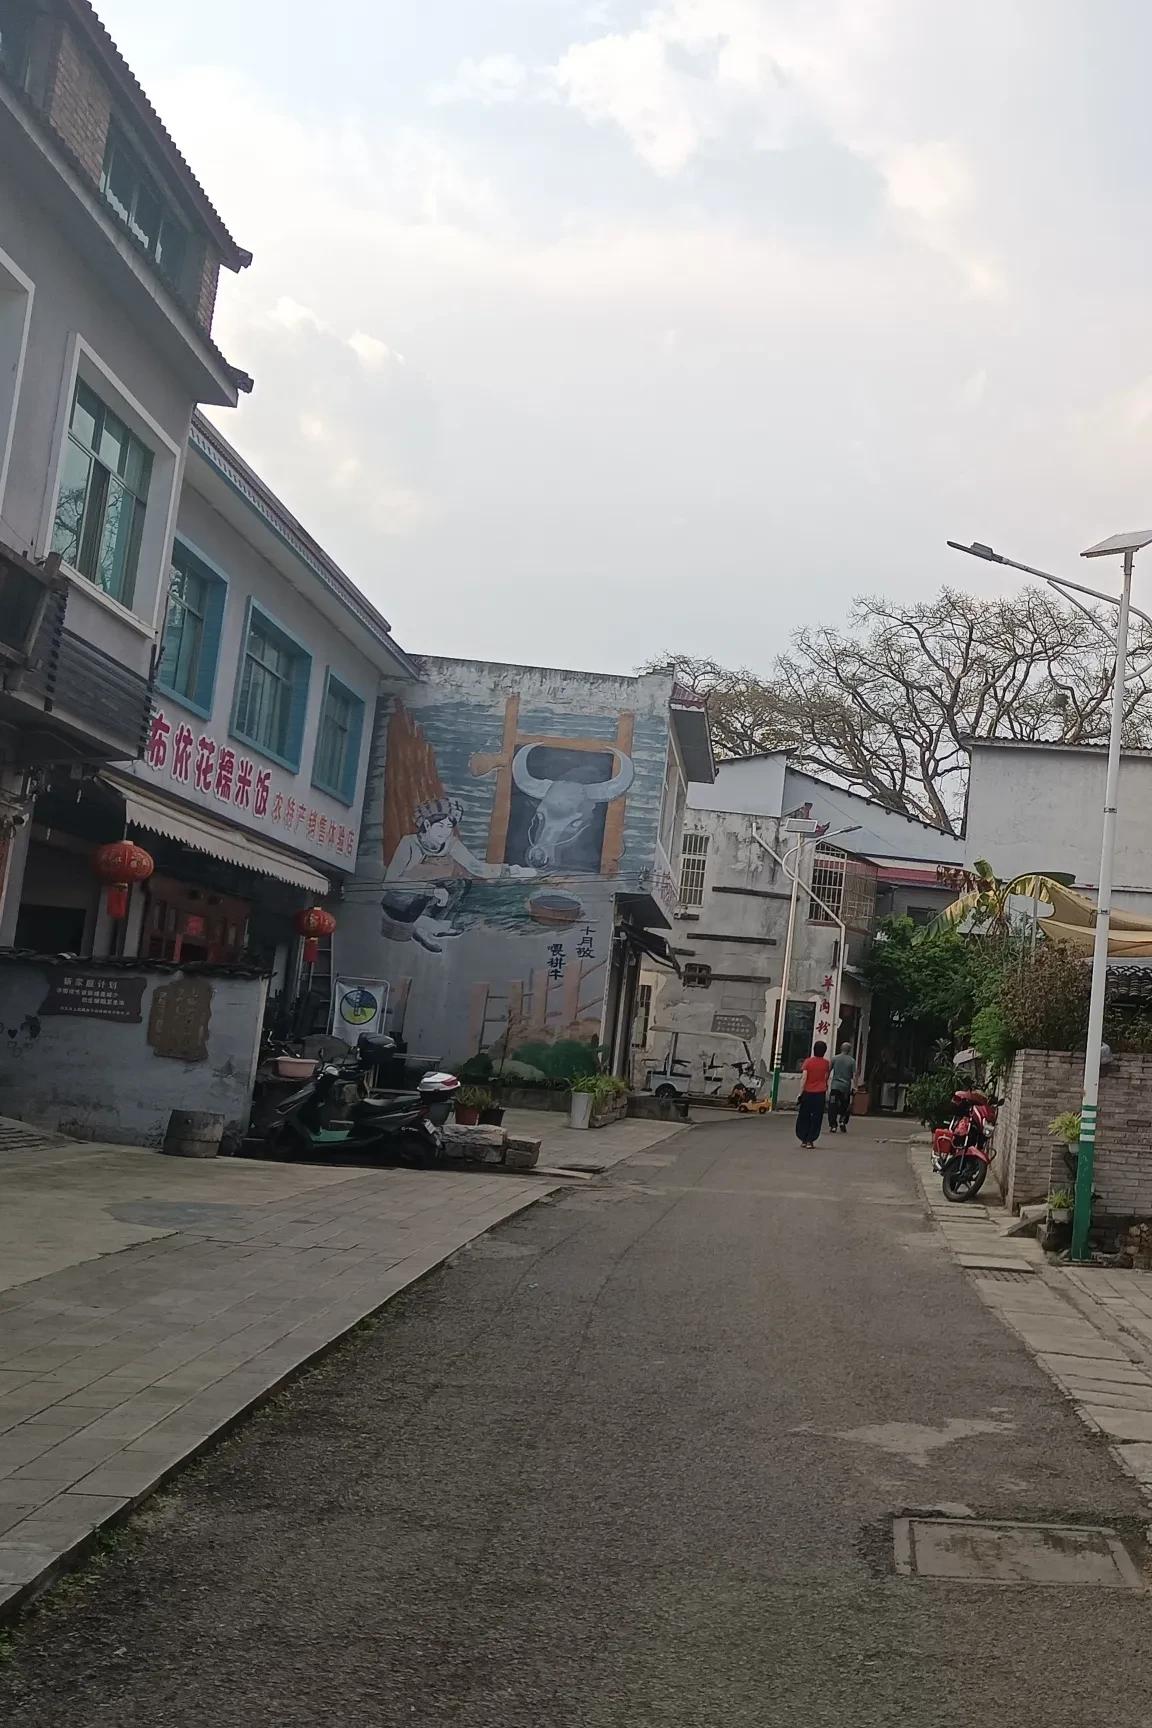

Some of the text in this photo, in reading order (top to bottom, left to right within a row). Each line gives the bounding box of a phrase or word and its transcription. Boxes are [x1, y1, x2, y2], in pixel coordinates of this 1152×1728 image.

[147, 711, 272, 817] 布依花糯米饭
[547, 944, 566, 980] 喂耕牛
[816, 975, 835, 1036] 羊肉粉
